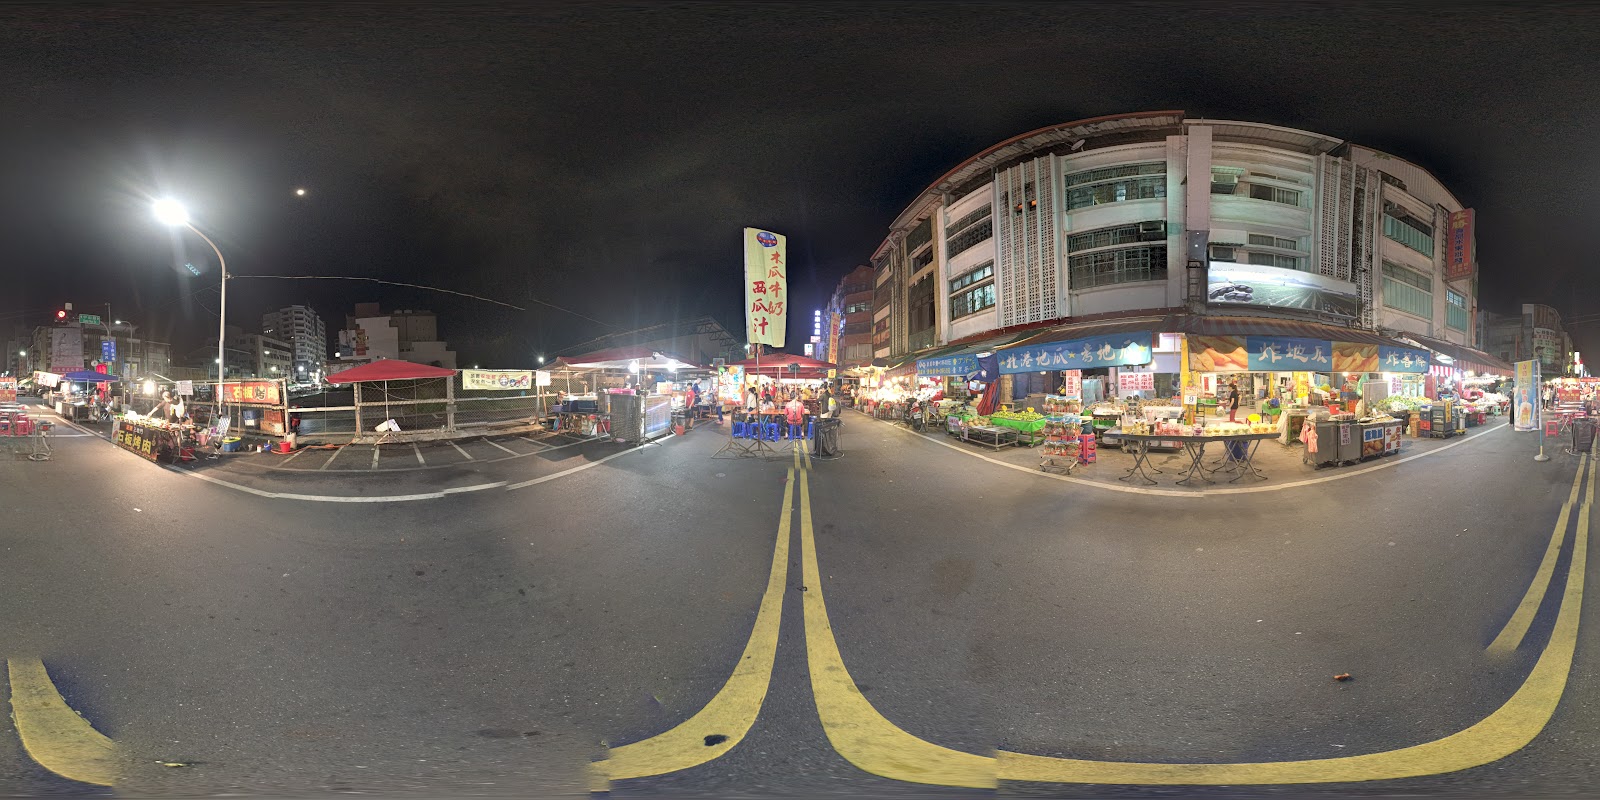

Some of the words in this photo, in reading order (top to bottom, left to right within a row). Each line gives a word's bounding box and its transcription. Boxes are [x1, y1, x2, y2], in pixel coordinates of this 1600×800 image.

[767, 251, 785, 316] 木瓜牛奶
[752, 280, 769, 335] 西瓜汁
[1006, 347, 1069, 369] 北港地瓜
[1258, 342, 1327, 363] 炸地瓜
[118, 430, 151, 454] 石板烤肉
